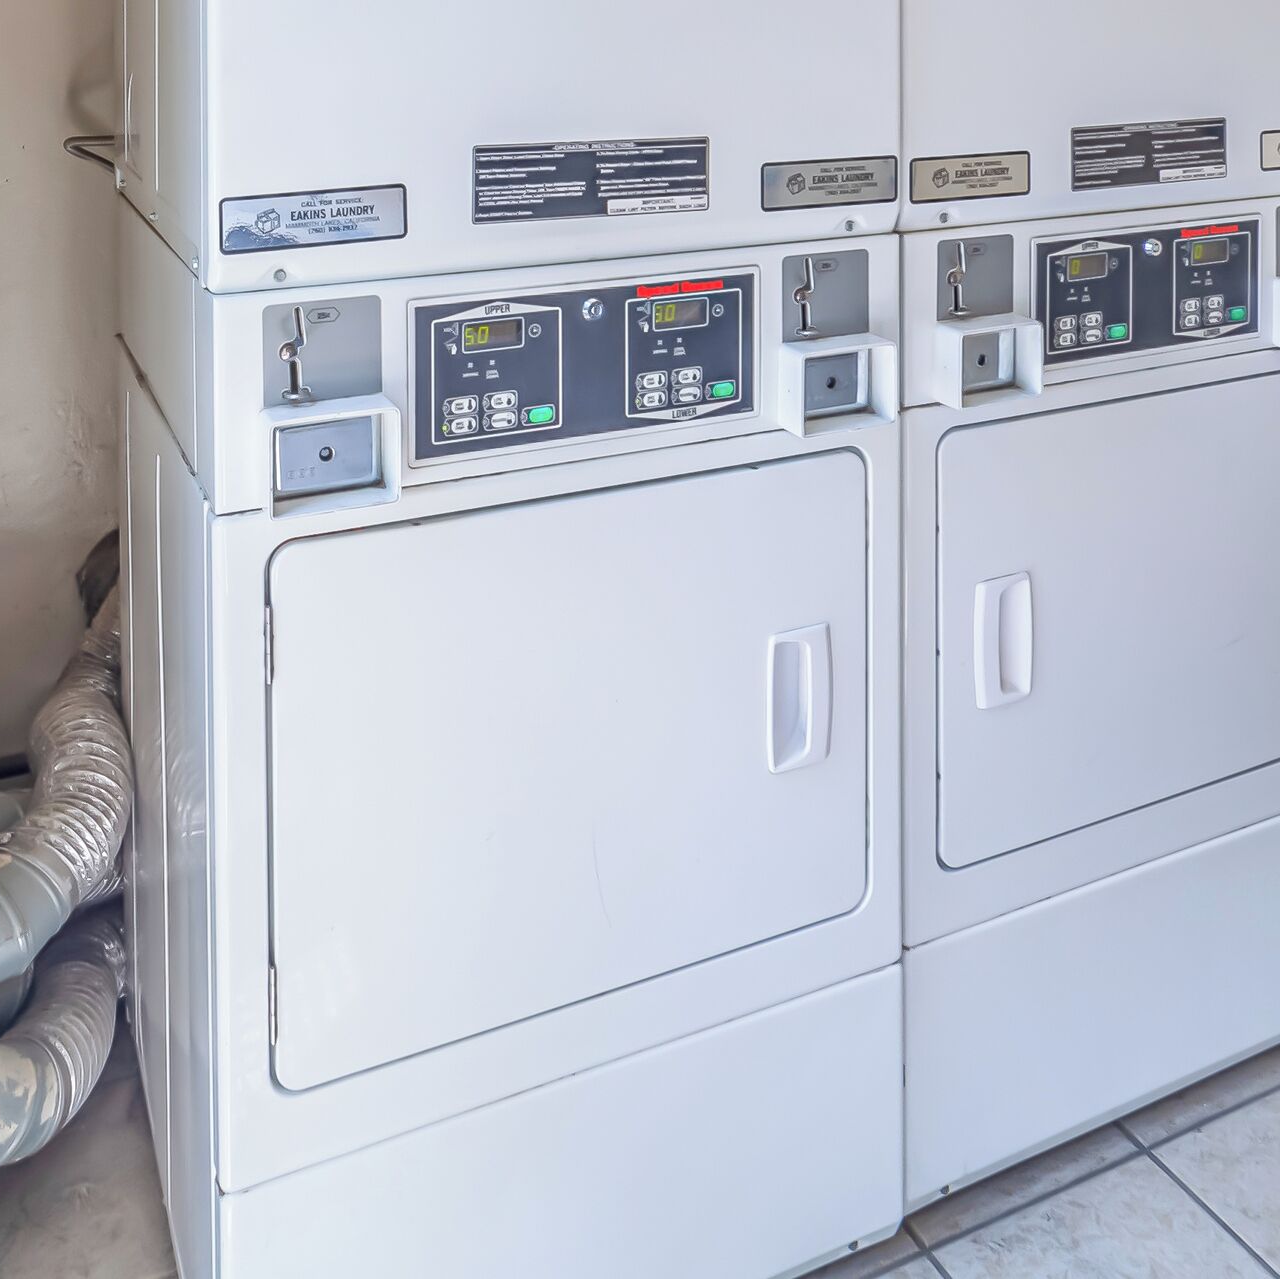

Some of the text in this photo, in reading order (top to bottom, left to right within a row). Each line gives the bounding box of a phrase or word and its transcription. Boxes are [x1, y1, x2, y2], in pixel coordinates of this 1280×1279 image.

[290, 204, 375, 221] EAKINS LAUNDRY
[484, 304, 510, 315] UPPER
[672, 407, 697, 419] LOWER
